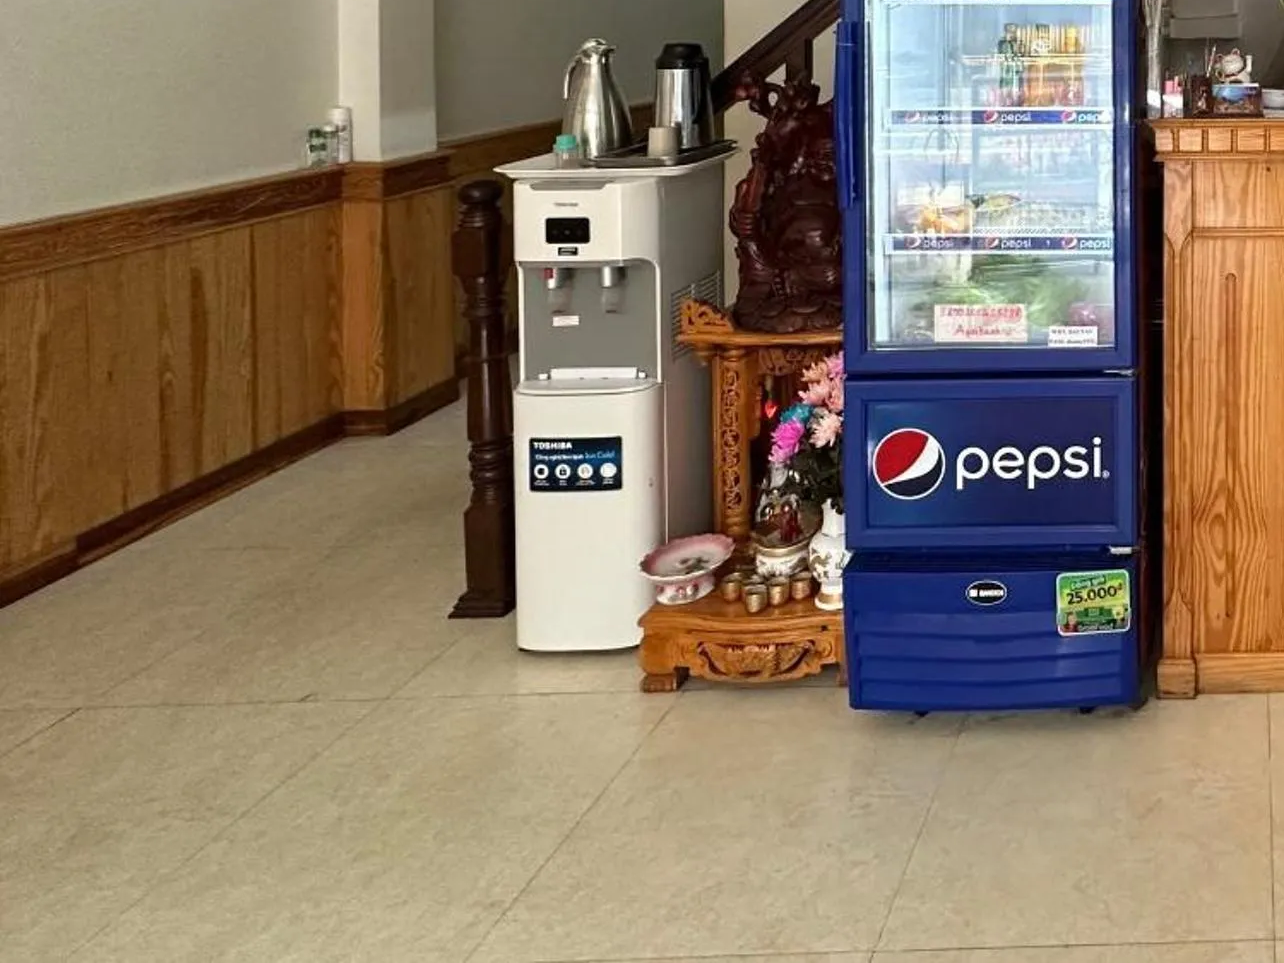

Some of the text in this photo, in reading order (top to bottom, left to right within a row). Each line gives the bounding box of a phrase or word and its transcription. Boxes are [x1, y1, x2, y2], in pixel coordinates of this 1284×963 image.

[1001, 113, 1031, 123] pepsi
[1001, 239, 1031, 250] pepsi
[1079, 239, 1111, 250] pepsi
[956, 437, 1101, 490] pepsi
